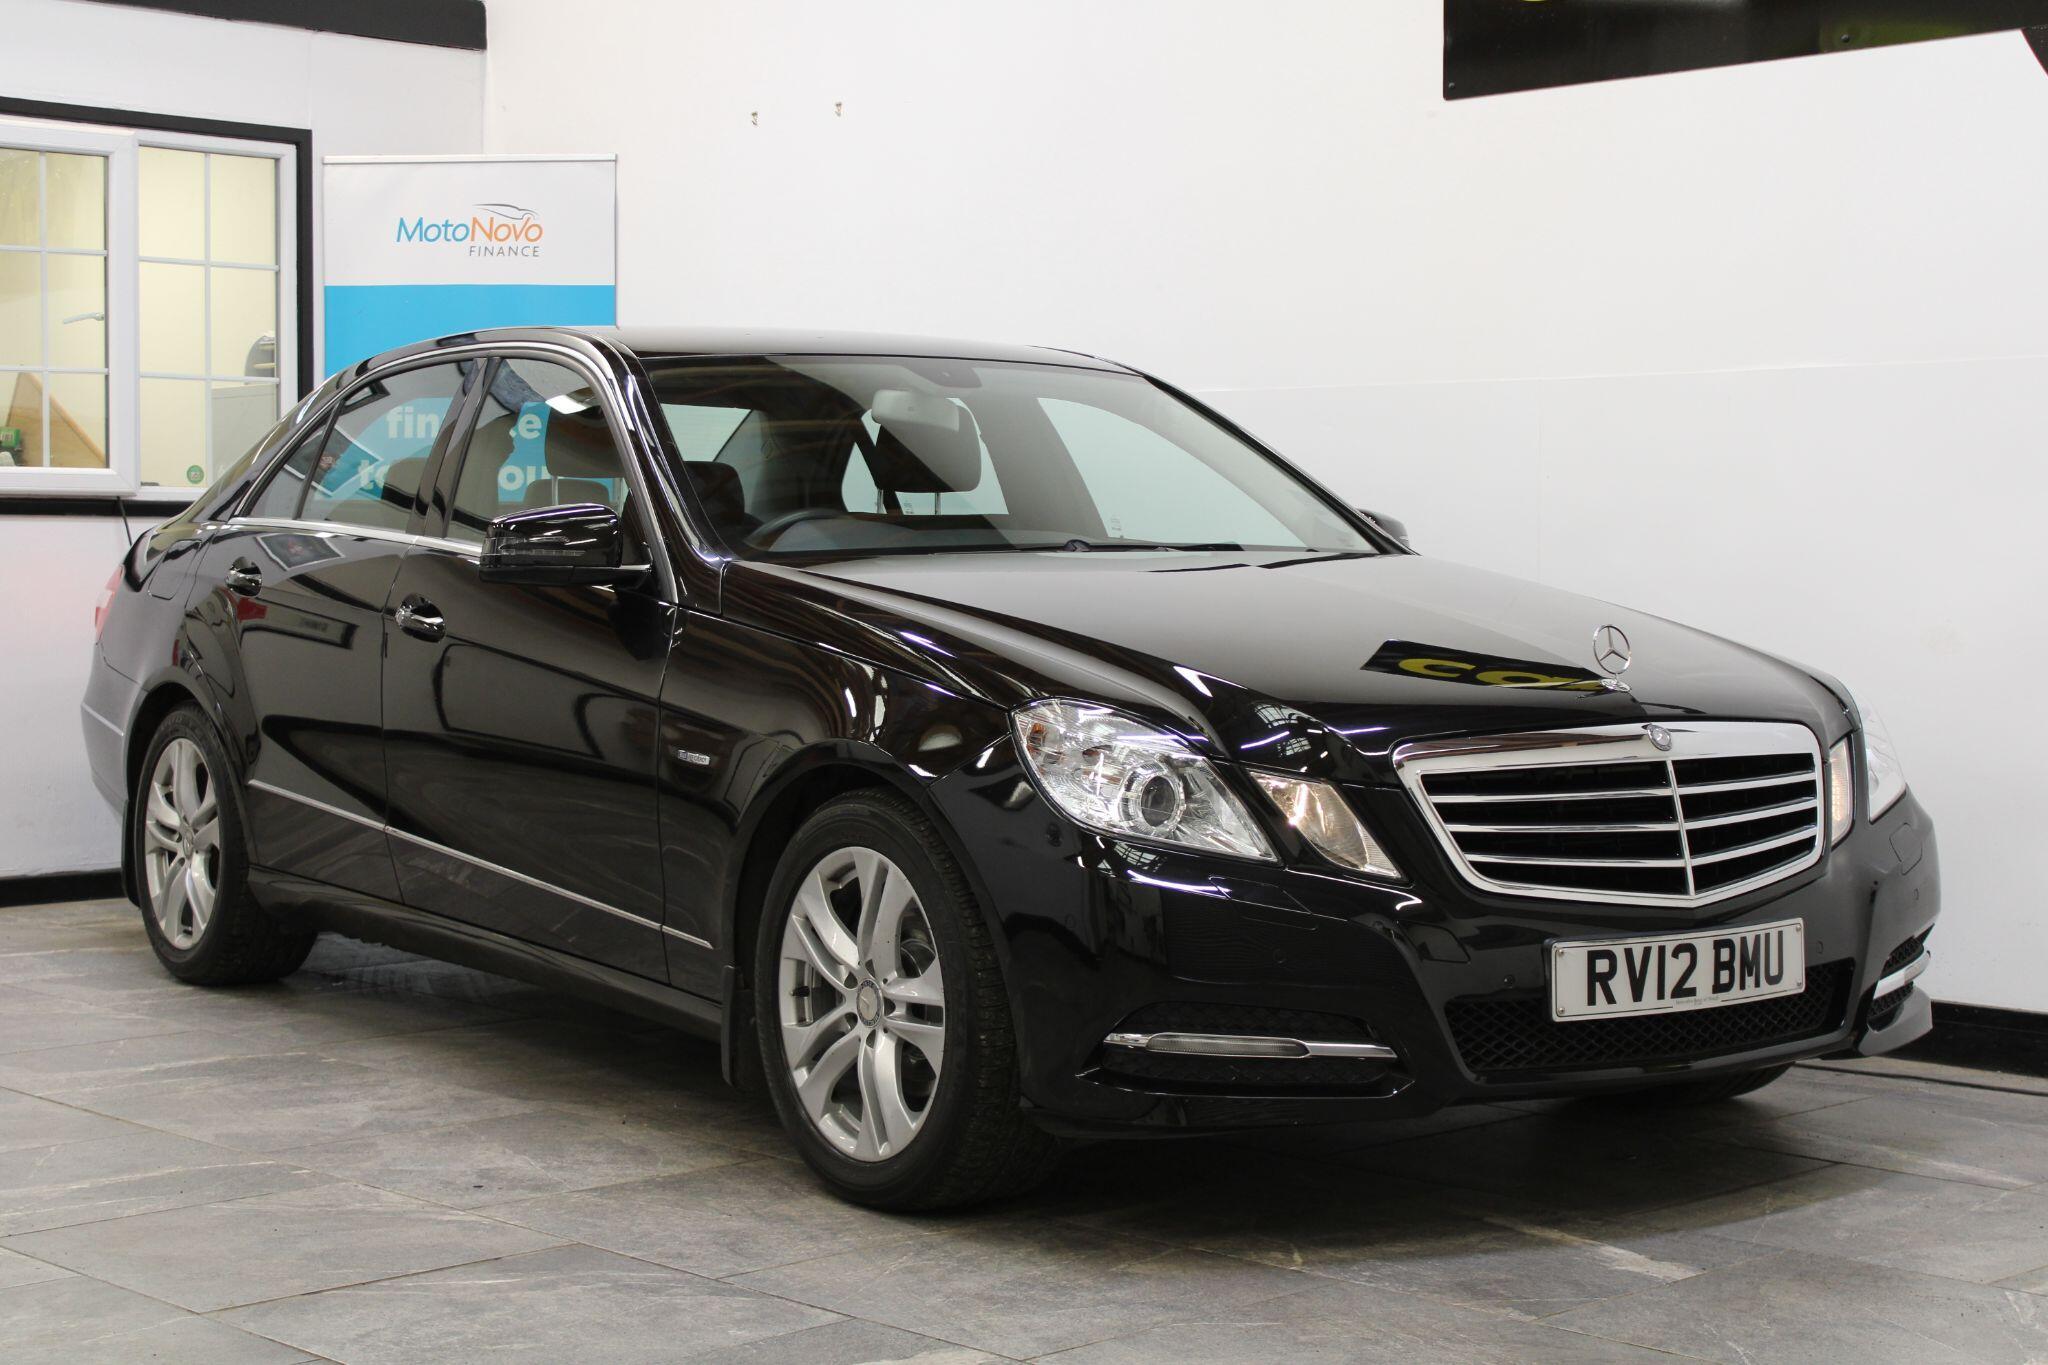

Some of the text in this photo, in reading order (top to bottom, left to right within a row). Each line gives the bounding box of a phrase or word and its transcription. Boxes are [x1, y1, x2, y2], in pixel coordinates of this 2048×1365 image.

[396, 216, 543, 242] MotoNovo
[468, 245, 541, 258] FINANCE
[1586, 930, 1785, 1007] RV12 BMU
